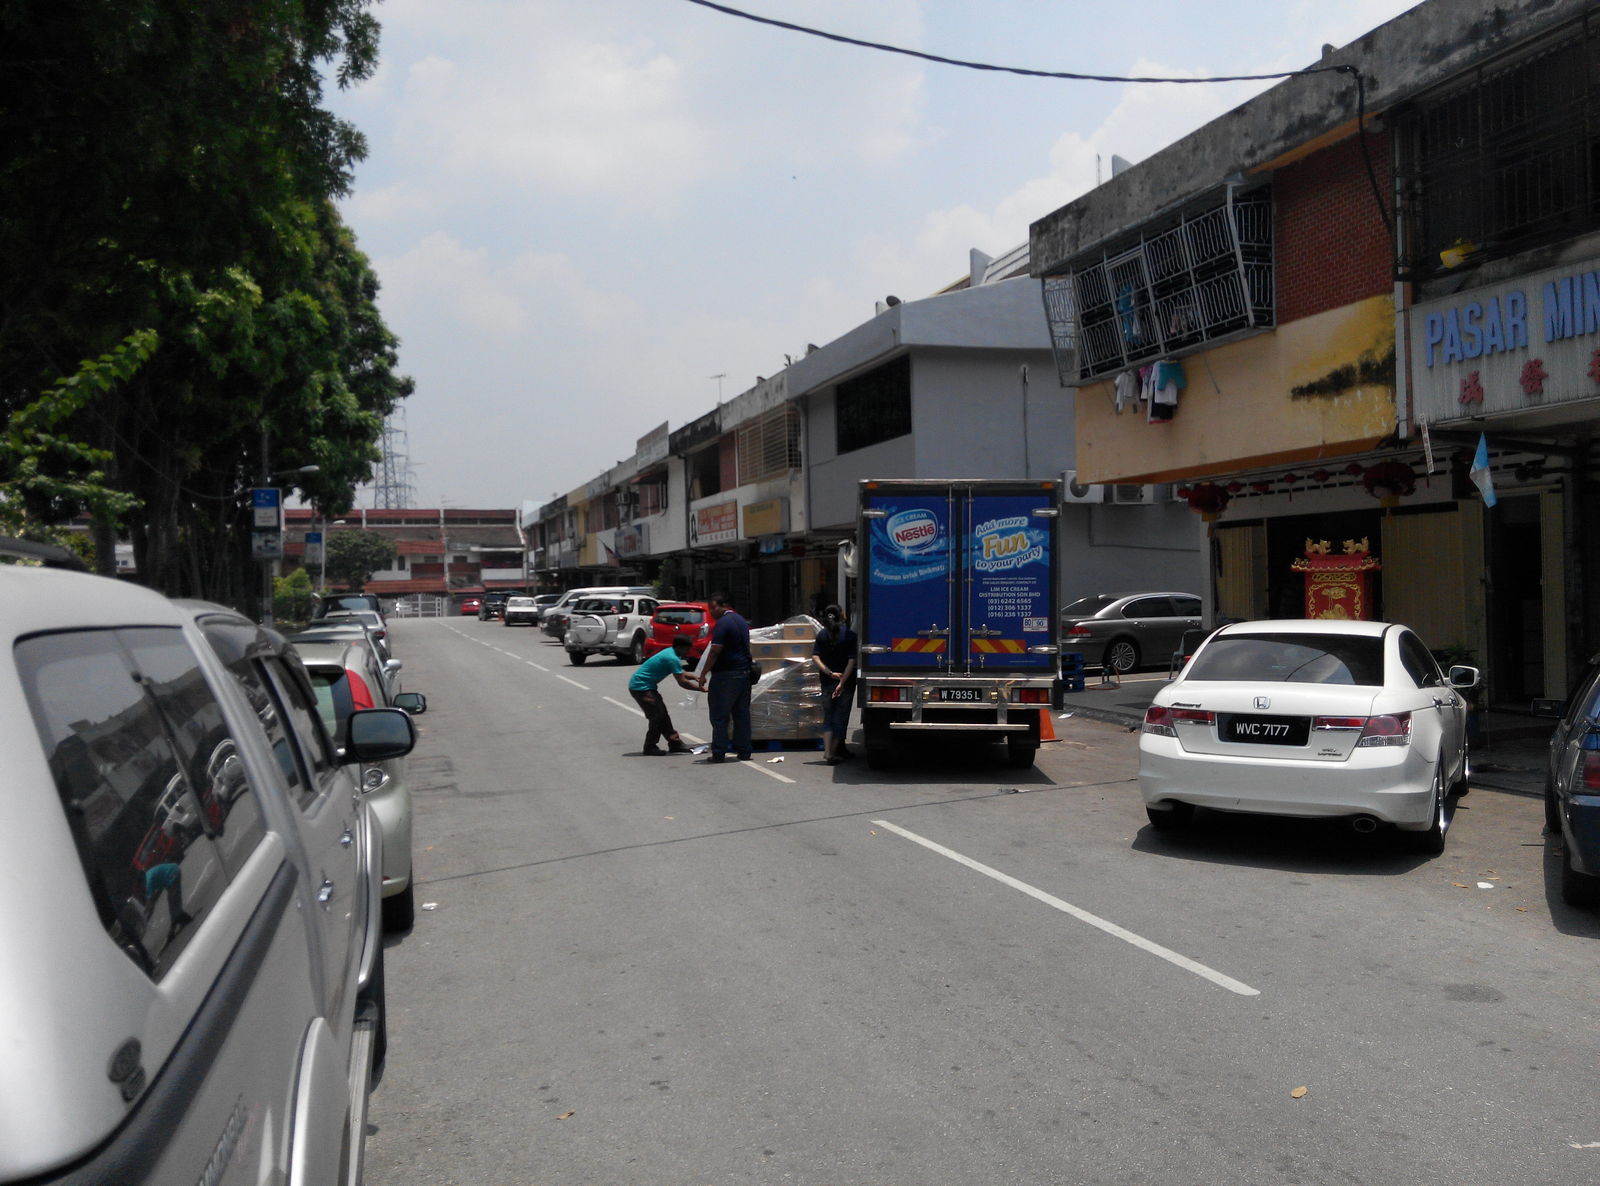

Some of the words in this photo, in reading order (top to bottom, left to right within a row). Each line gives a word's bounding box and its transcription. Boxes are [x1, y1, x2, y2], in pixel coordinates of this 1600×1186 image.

[1425, 290, 1528, 368] PASAR
[976, 520, 995, 537] Add
[998, 517, 1027, 528] more
[983, 533, 1029, 558] Fun
[976, 559, 987, 569] to
[989, 558, 1014, 570] your
[1016, 546, 1041, 565] party
[941, 690, 948, 699] W
[950, 690, 973, 699] 7935
[975, 690, 981, 700] L
[1236, 722, 1260, 736] WVC
[1262, 724, 1290, 737] 7177
